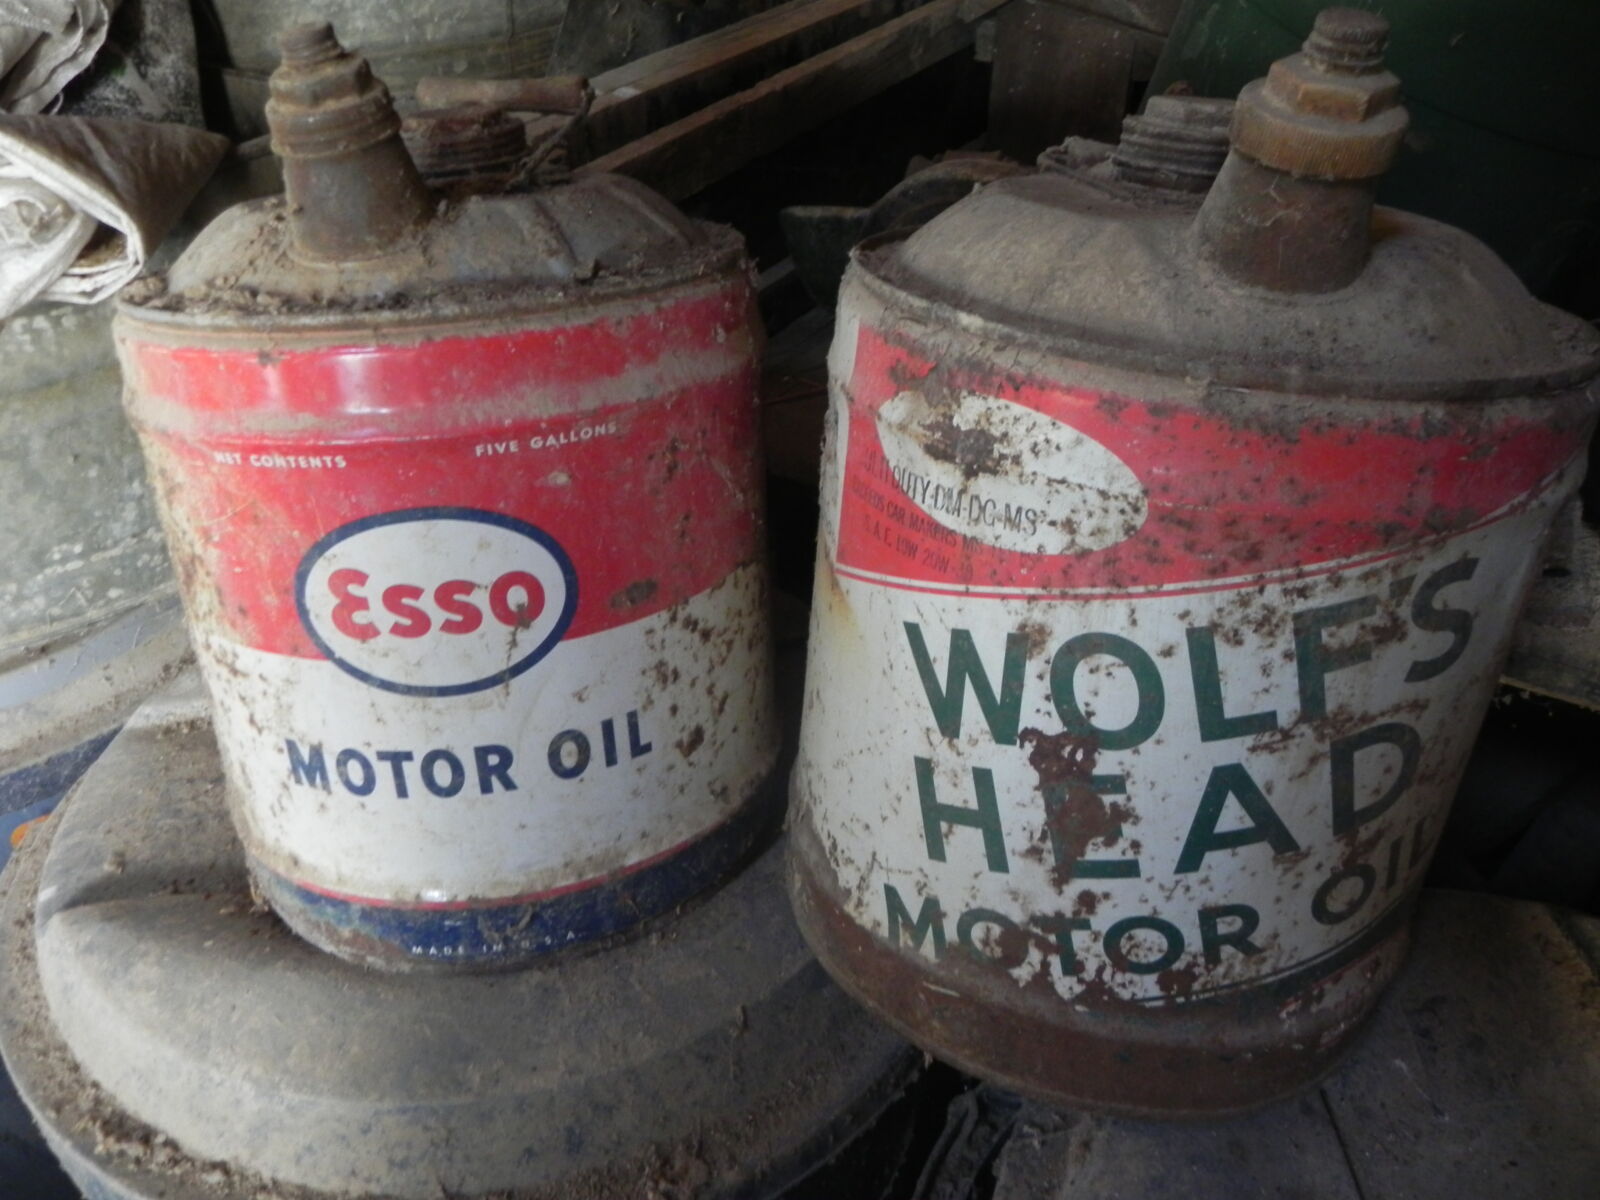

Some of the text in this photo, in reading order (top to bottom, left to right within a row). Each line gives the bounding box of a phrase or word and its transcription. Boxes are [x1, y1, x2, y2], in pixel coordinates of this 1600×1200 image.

[249, 453, 347, 469] CONTENTS
[475, 421, 618, 458] FIVE GALLONS
[903, 557, 1481, 752] WOLF'S
[285, 709, 653, 799] MOTOR OIL
[913, 721, 1422, 880] HEAD
[883, 816, 1435, 978] MOTOR OIL
